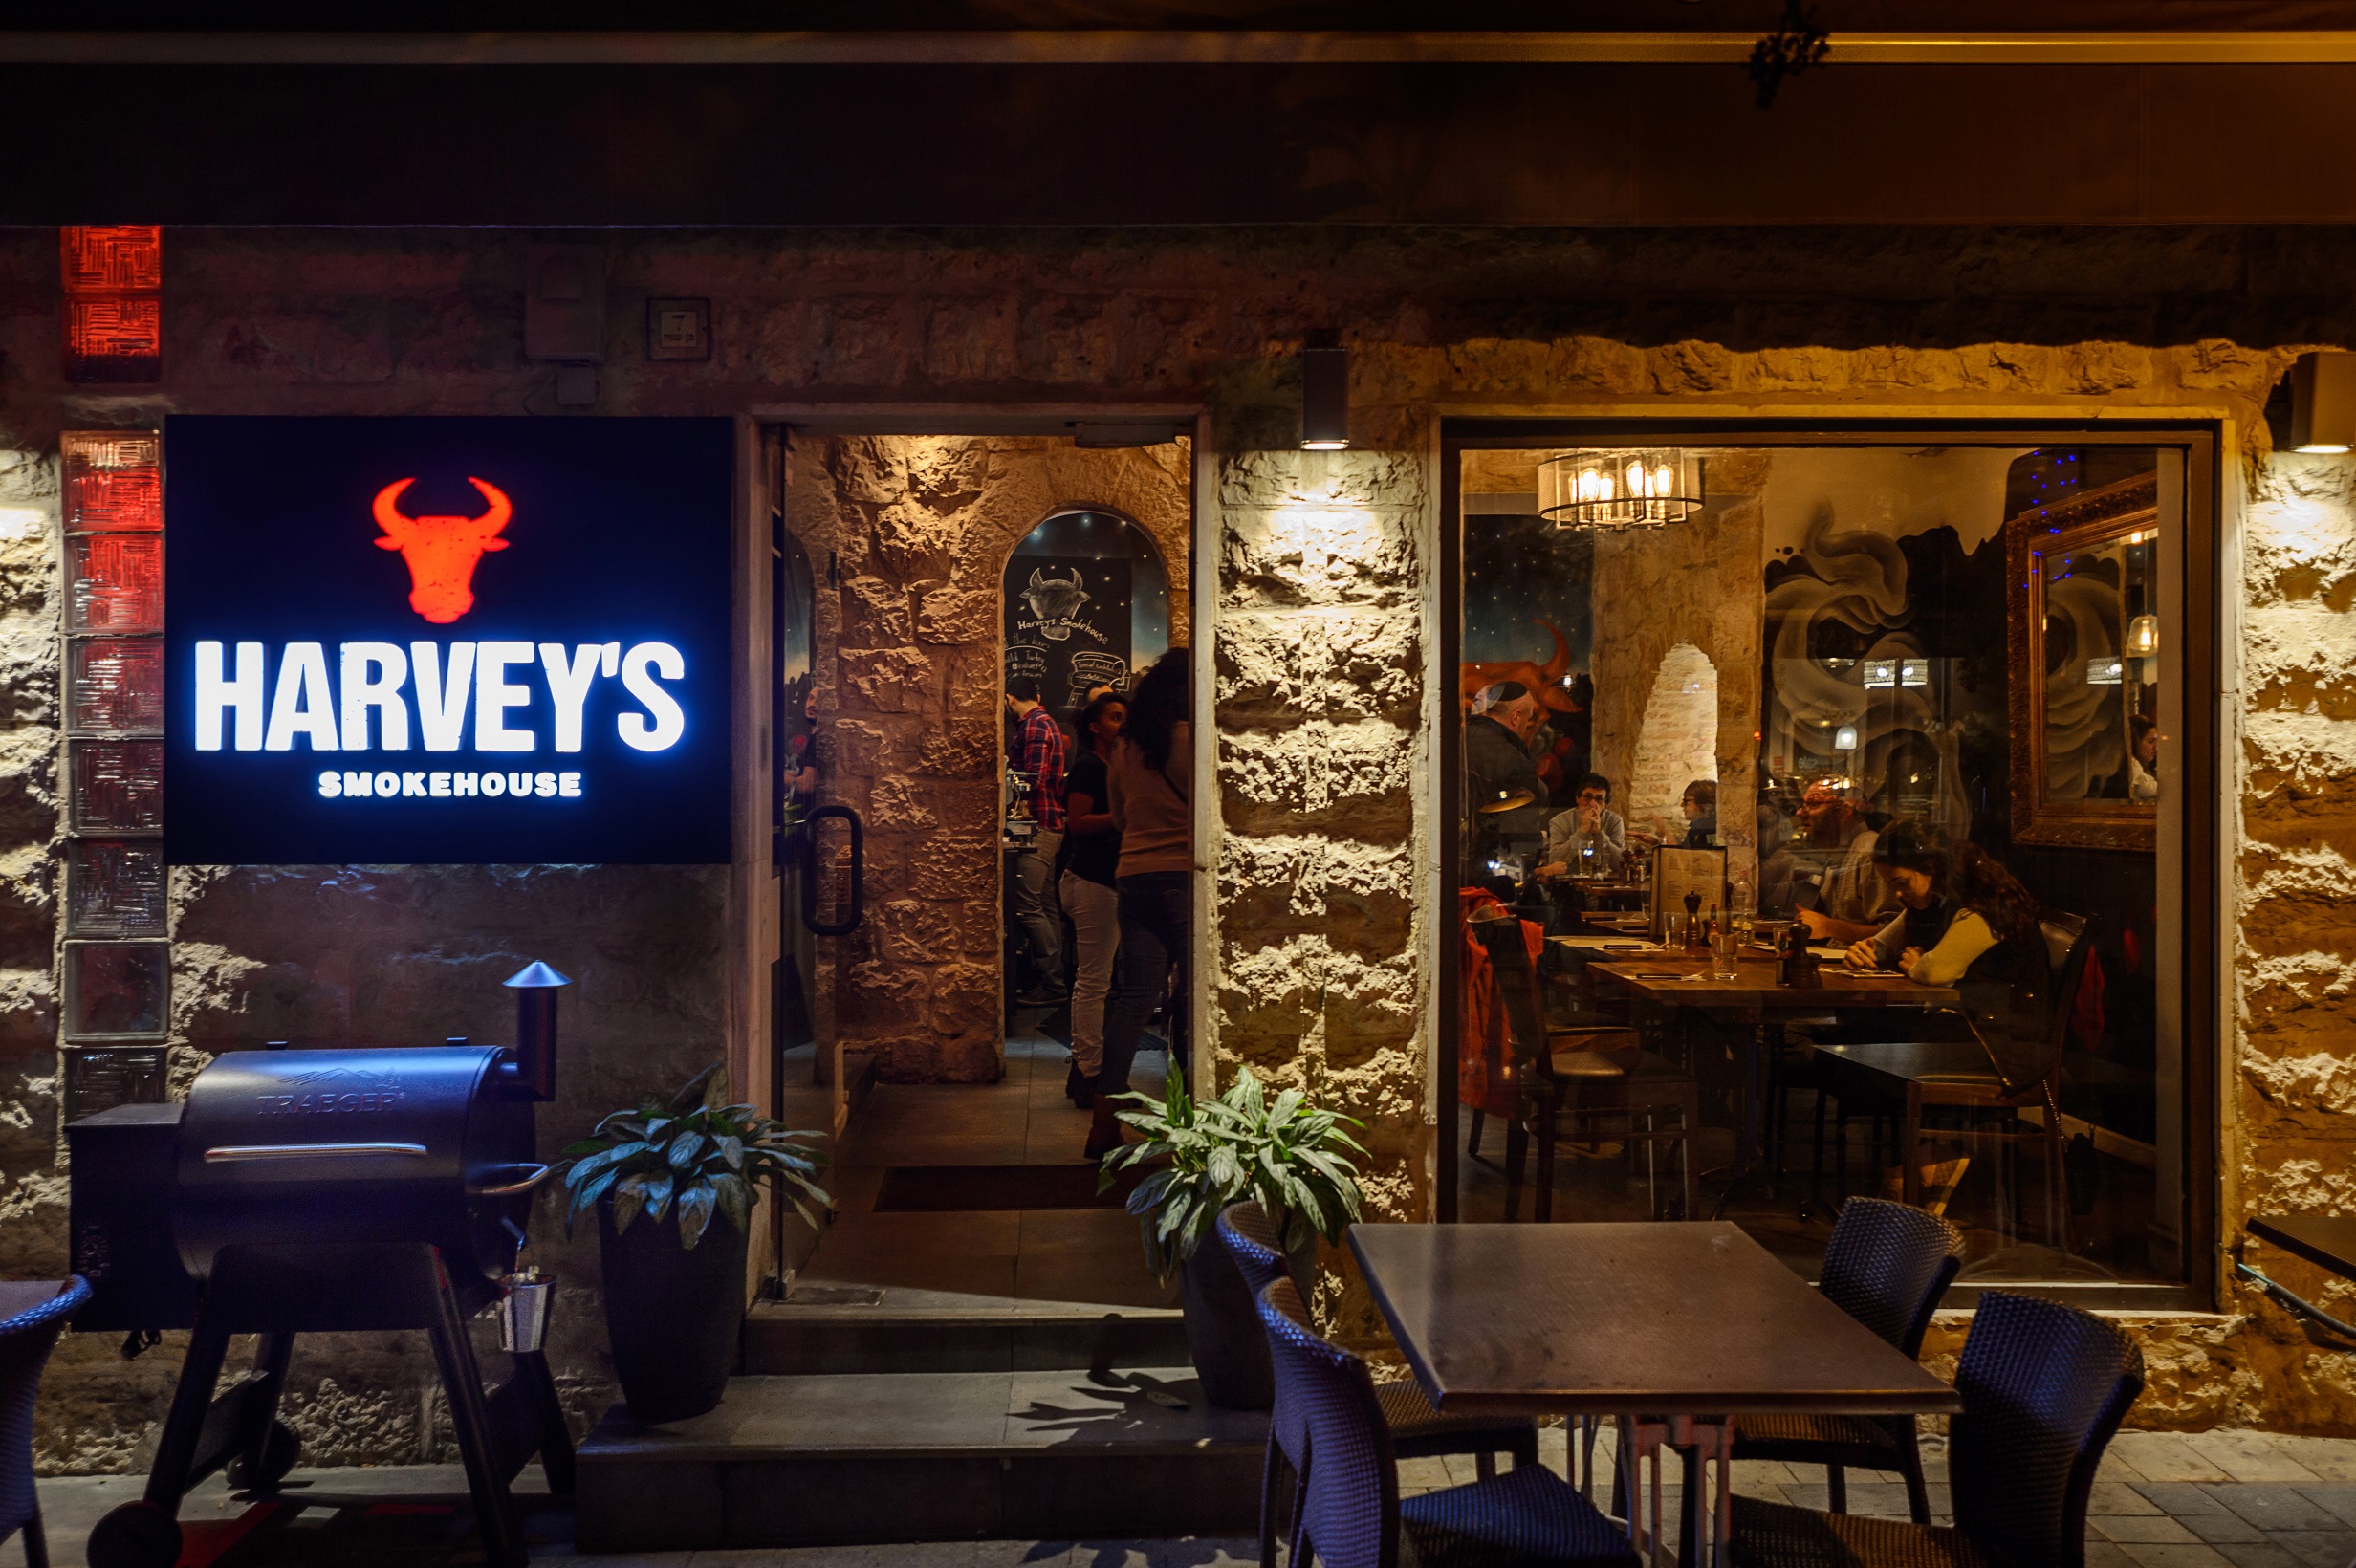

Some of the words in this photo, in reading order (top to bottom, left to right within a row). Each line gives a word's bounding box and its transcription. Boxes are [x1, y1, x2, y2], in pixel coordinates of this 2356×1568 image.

[195, 641, 685, 752] HARVEY'S
[318, 771, 581, 797] SMOKEHOUSE
[257, 1093, 397, 1115] TRAEGER
